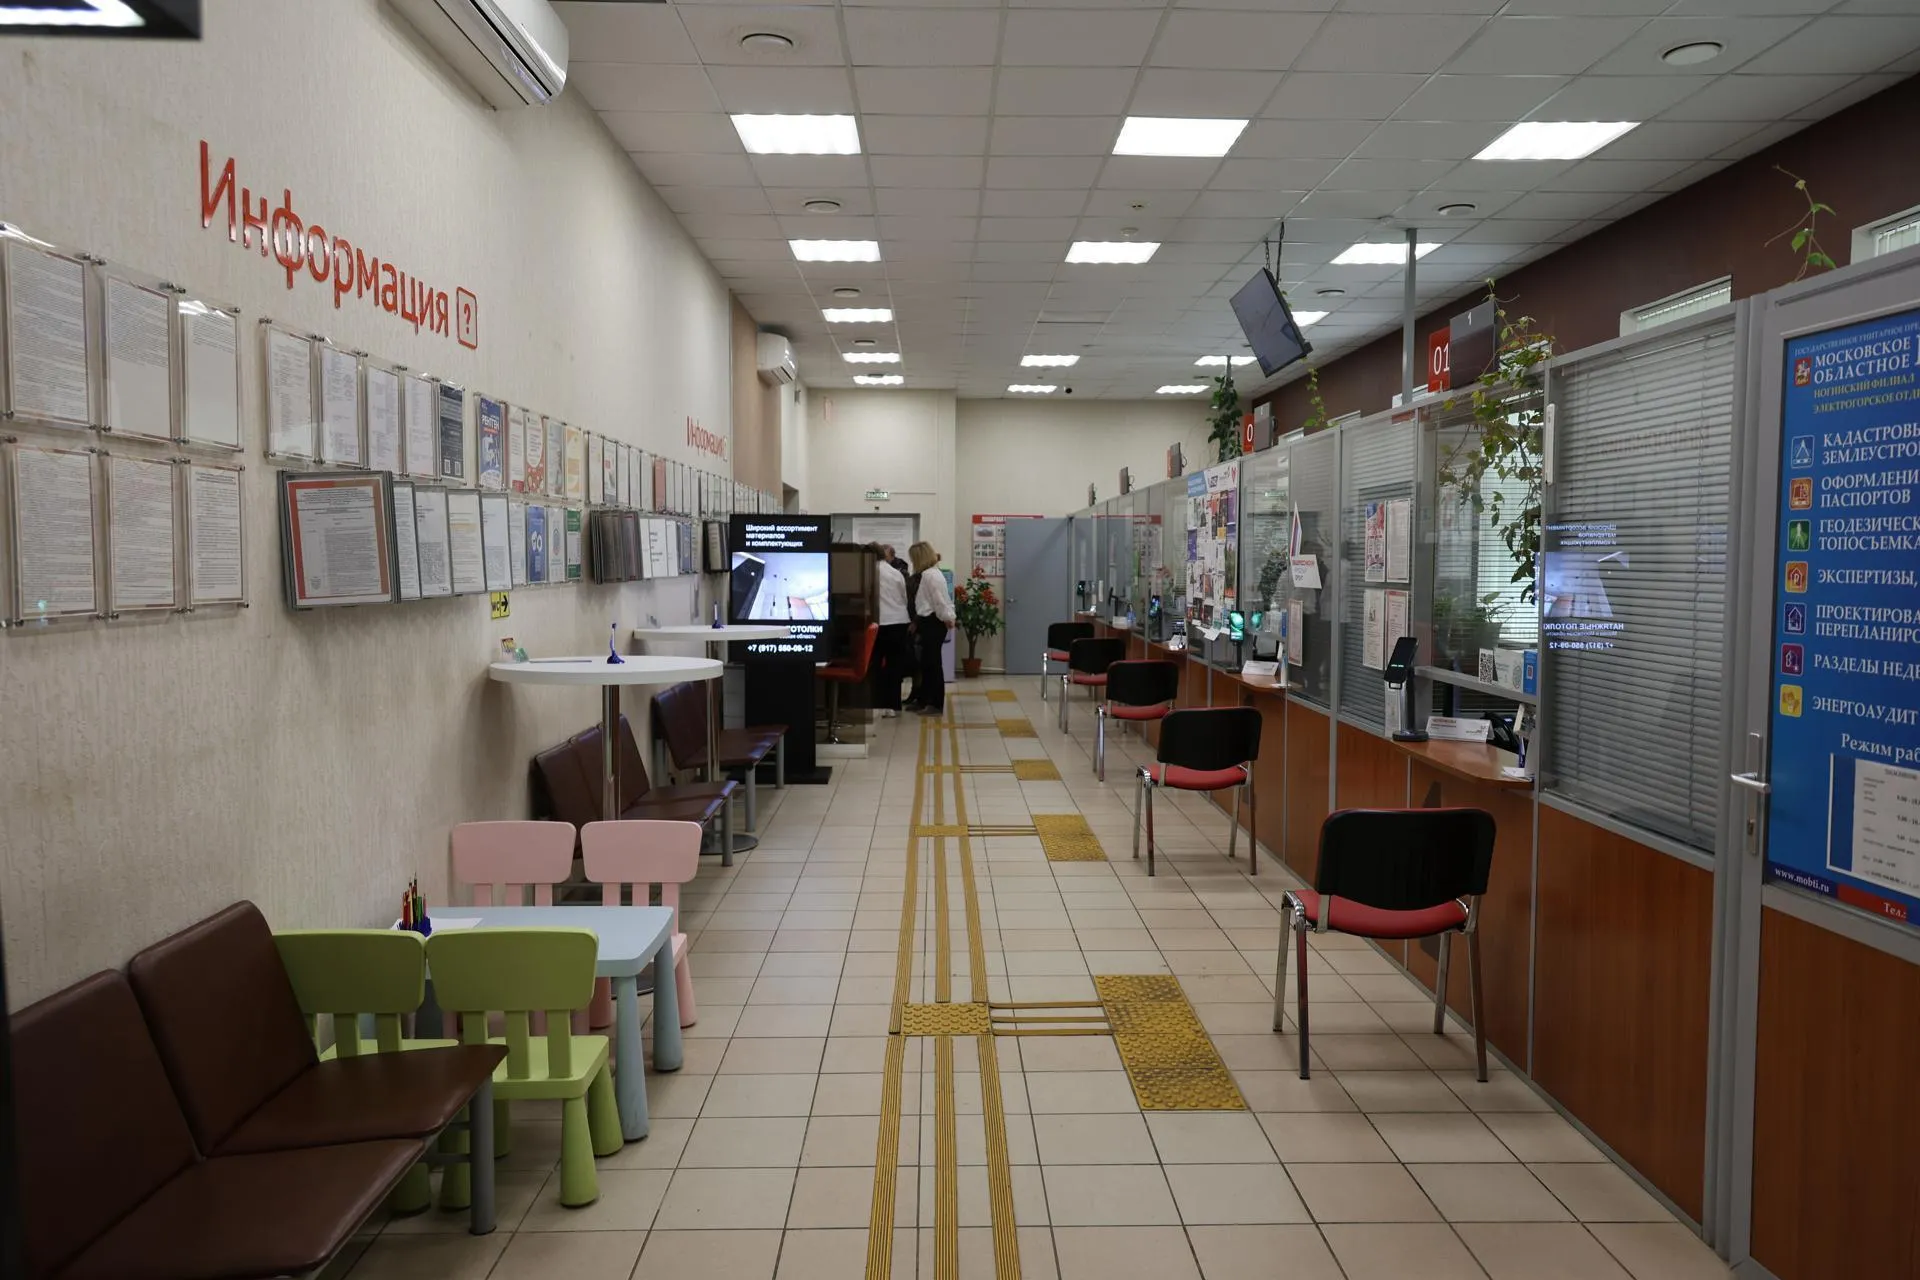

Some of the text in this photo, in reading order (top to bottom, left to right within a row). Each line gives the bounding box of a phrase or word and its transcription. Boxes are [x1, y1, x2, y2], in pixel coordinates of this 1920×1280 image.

[200, 139, 449, 338] Информация
[1467, 311, 1472, 326] 1
[1433, 342, 1450, 375] 01
[1815, 336, 1911, 368] МОСКОВСКОЕ
[1814, 353, 1910, 384] ОБЛАСТНОЕ
[1822, 441, 1920, 466] ЗЕМЛЕУСТРО
[1820, 488, 1911, 508] ПАСПОРТОВ
[745, 524, 775, 532] Широкий
[745, 533, 785, 541] материалов
[751, 541, 804, 549] комплектующих
[1817, 569, 1918, 588] ЭКСПЕРТИЗЫ,
[1814, 653, 1879, 674] РАЗДЕЛЫ
[1812, 695, 1918, 725] ЭНЕРГОАУДИТ
[1841, 733, 1892, 757] Режим
[1774, 867, 1830, 894] www.mobti.ru
